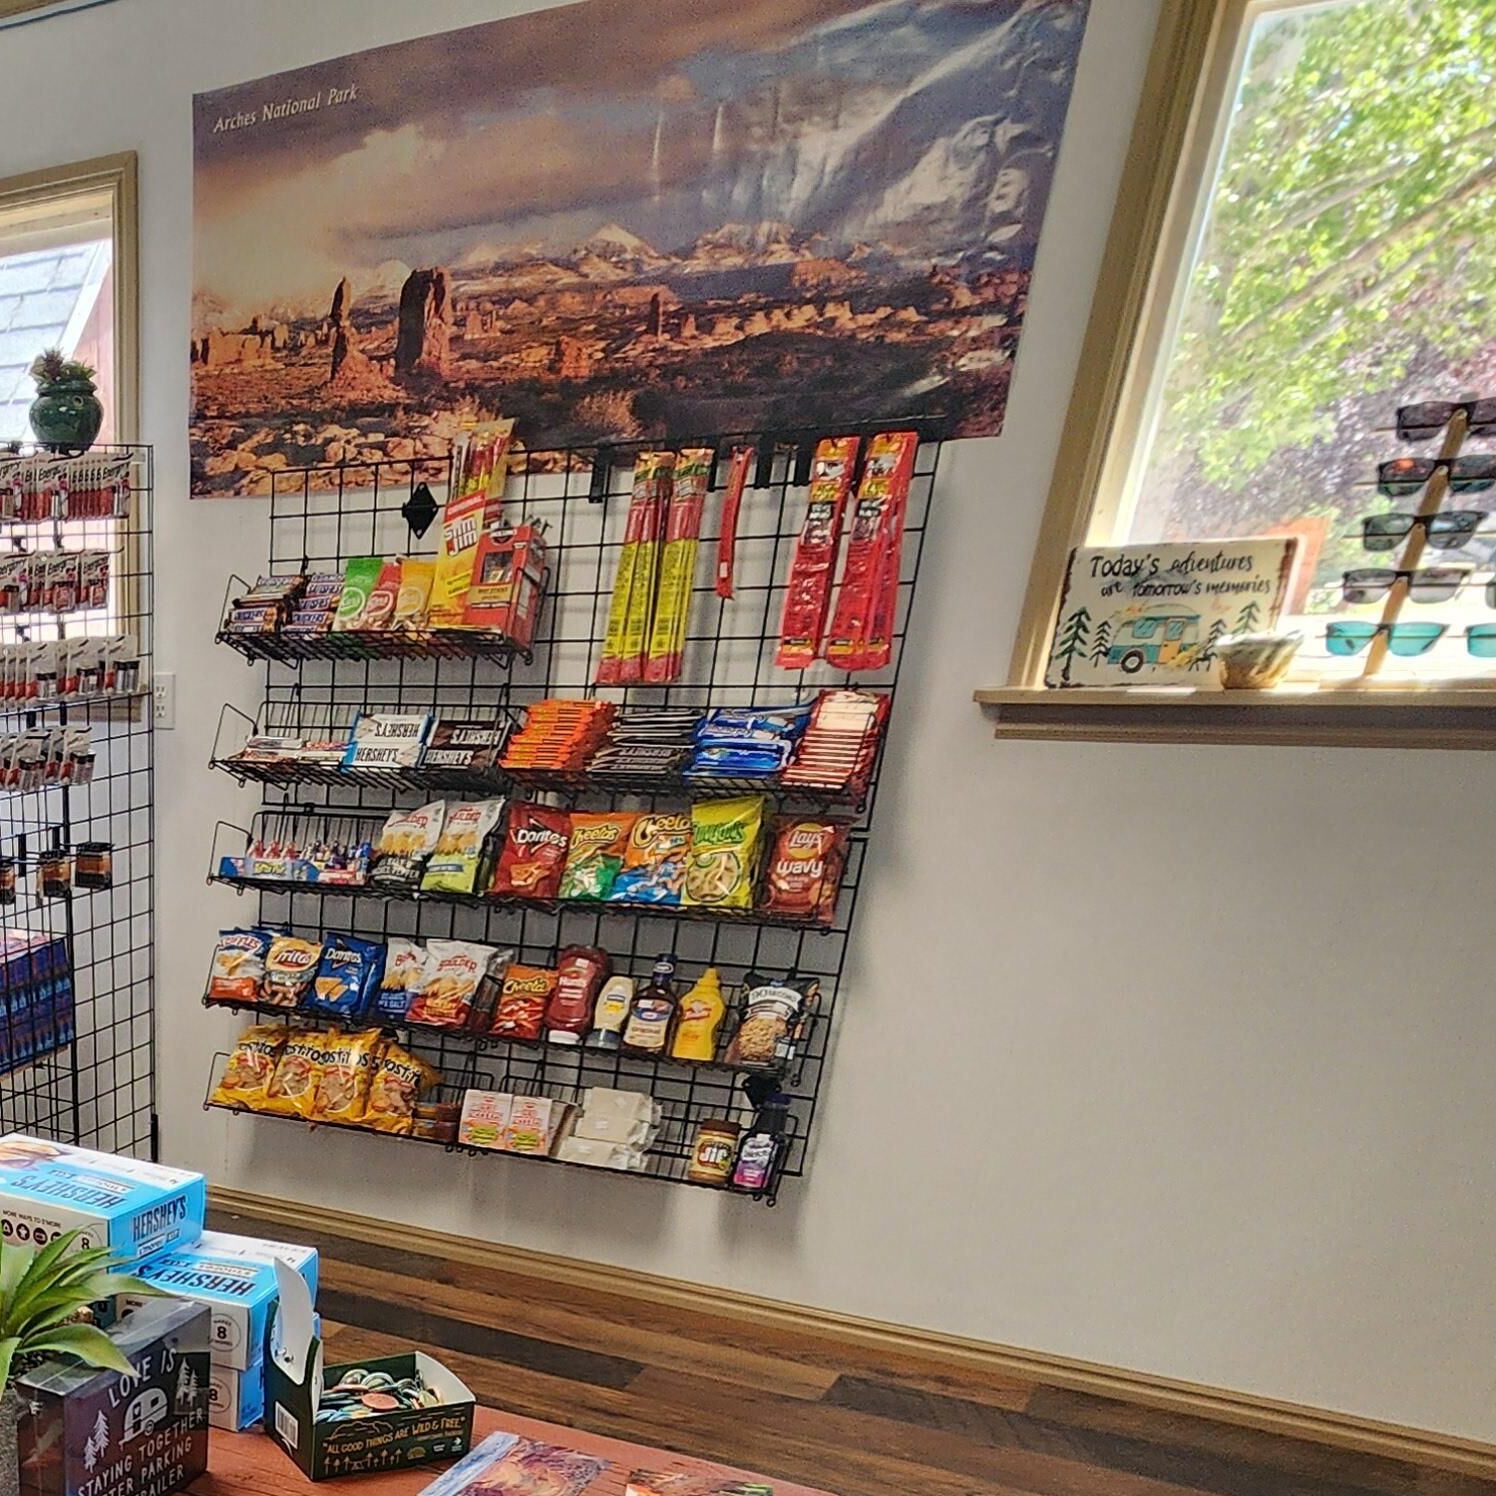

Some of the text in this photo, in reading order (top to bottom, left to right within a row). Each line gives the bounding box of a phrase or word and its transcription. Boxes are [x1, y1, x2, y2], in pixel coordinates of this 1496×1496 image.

[212, 84, 358, 134] Arches National Park
[1089, 550, 1253, 578] Today's adventures
[1132, 578, 1201, 598] tomorrow's
[1206, 577, 1271, 595] memories
[517, 829, 568, 848] Doritos
[11, 1175, 128, 1209] HERSHEY'S
[131, 1194, 187, 1243] HERSHEY'S
[81, 1237, 91, 1250] 8
[136, 1264, 257, 1297] HERSHEY'S
[217, 1325, 227, 1340] 8
[108, 1349, 178, 1408] LOVE IS
[138, 1407, 206, 1457] TOGETHER
[341, 1437, 365, 1453] GOOD
[140, 1436, 193, 1485] PARKING
